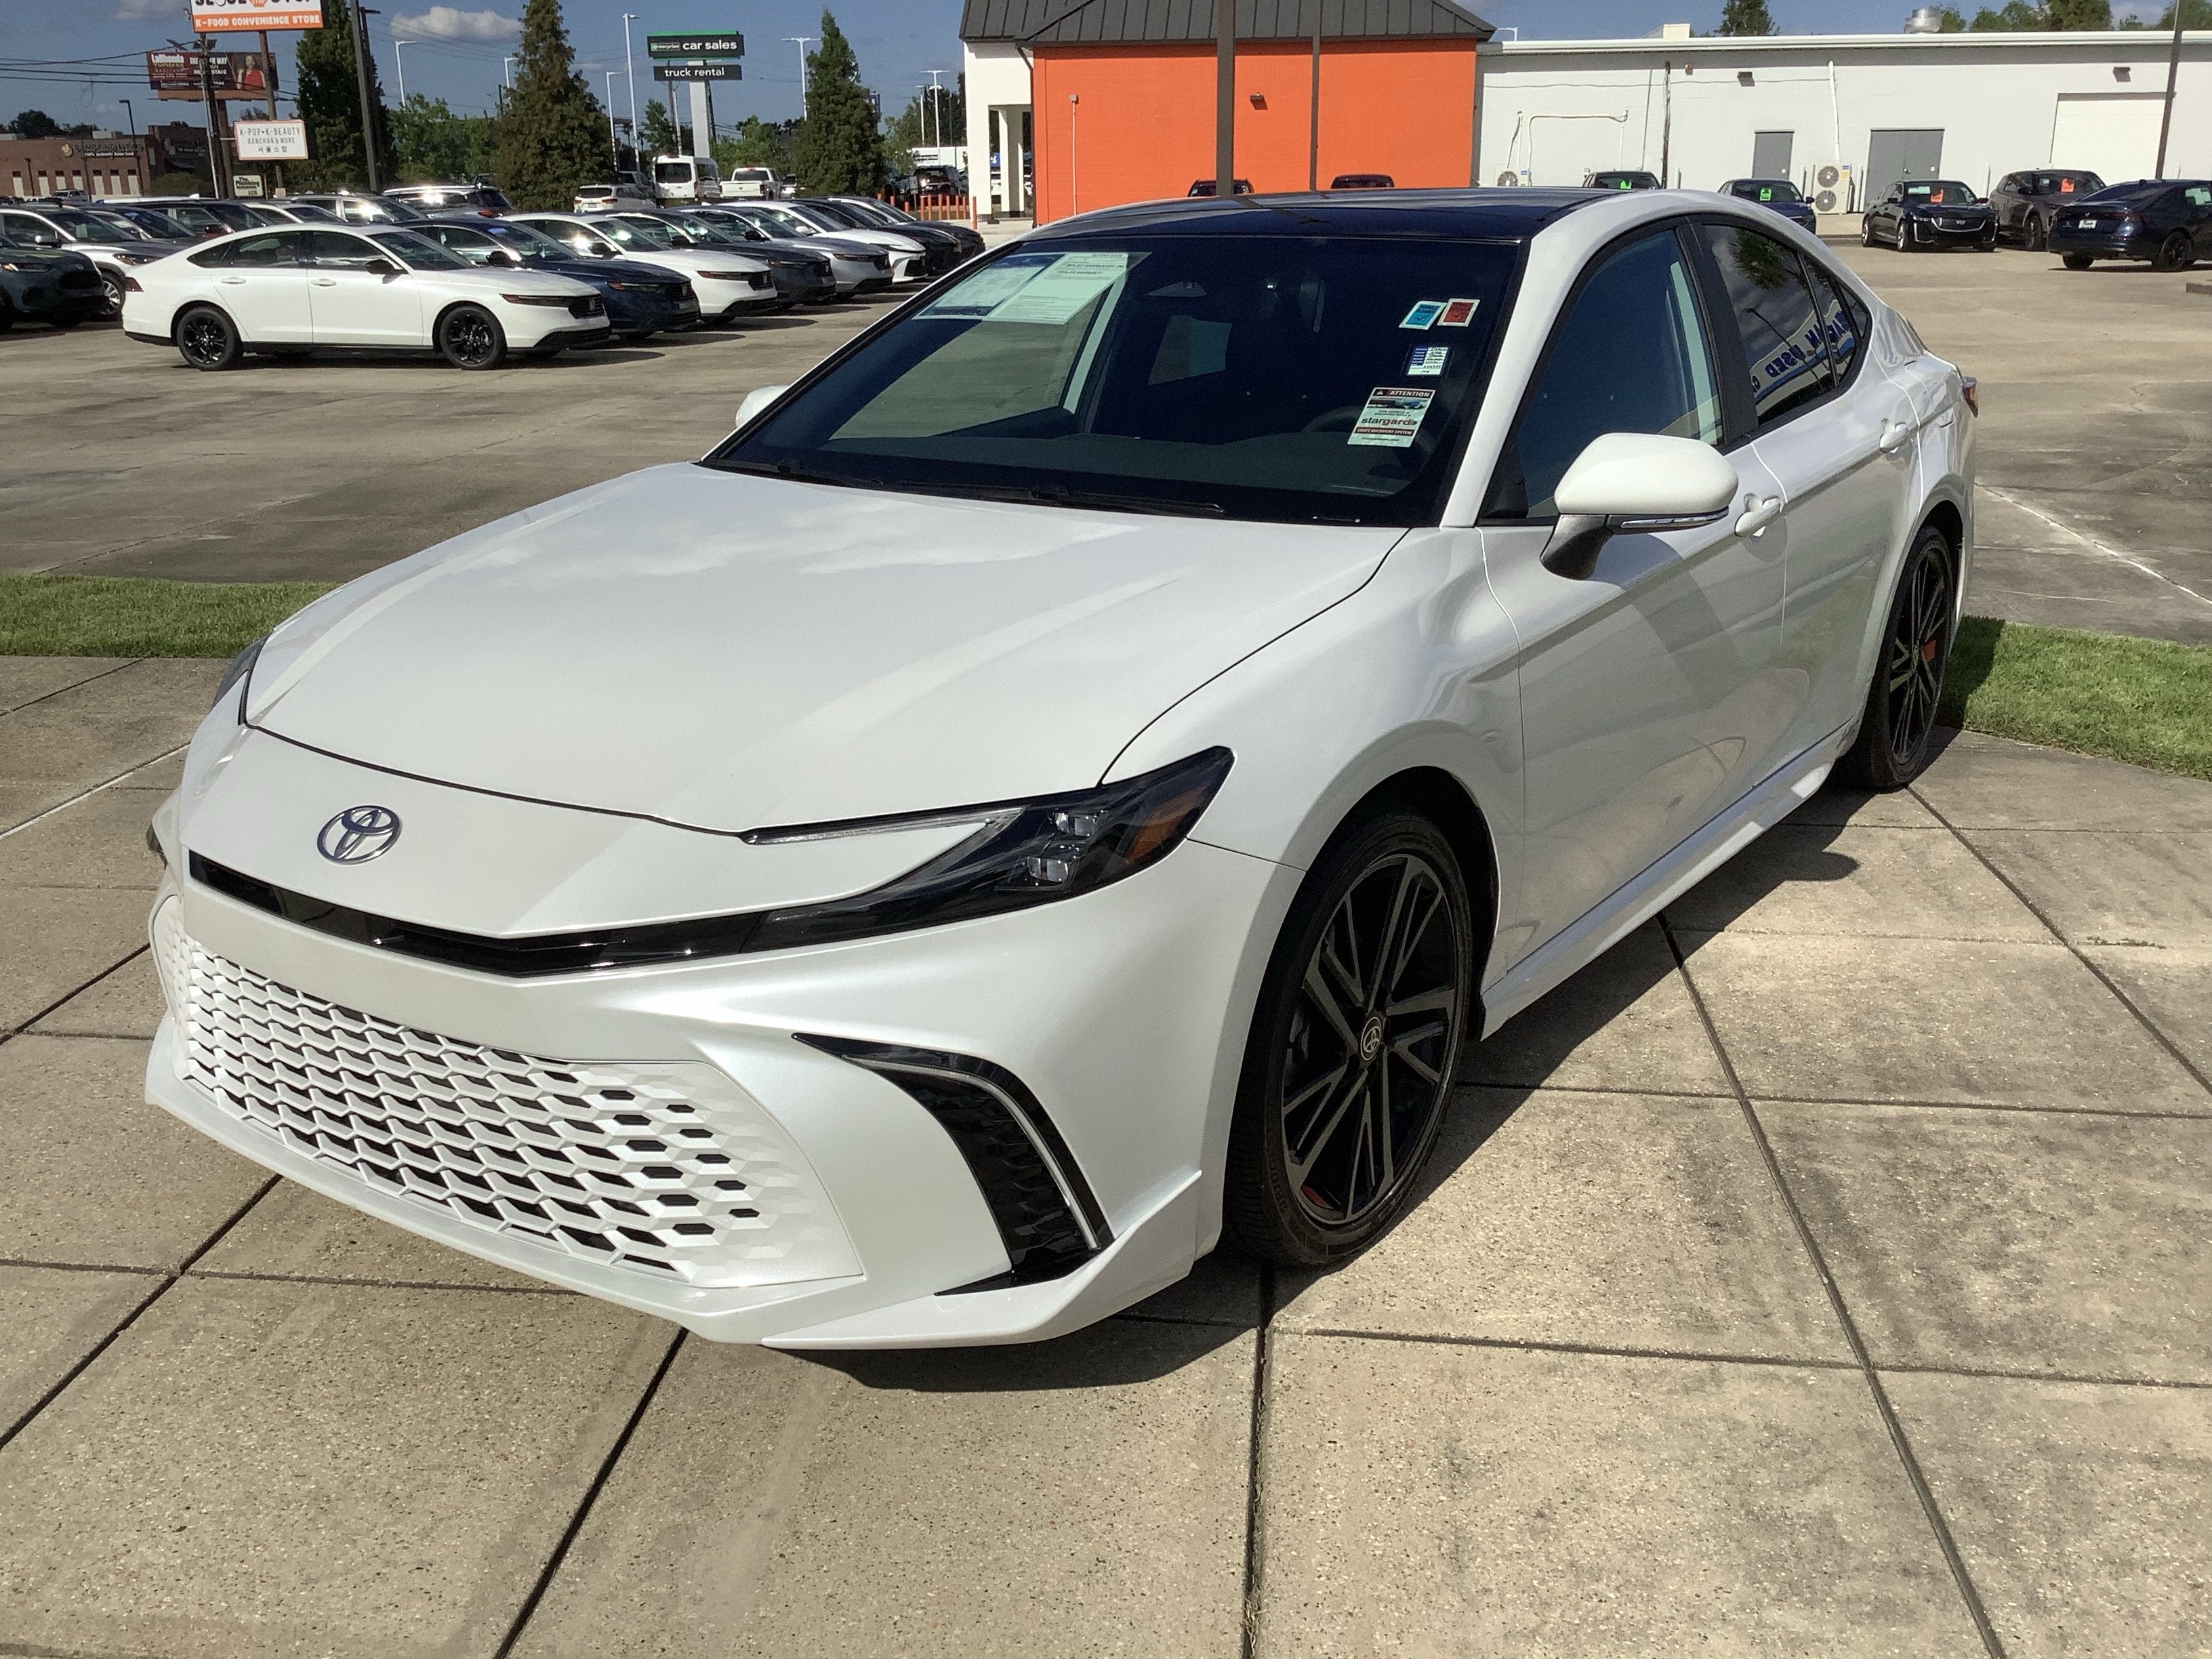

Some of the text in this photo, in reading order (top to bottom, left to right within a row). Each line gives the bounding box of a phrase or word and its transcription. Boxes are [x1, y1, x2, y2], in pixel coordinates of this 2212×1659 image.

[195, 14, 320, 28] K-FOOD CONVENIENCE STORE
[682, 42, 703, 50] car
[705, 39, 737, 50] sales
[664, 66, 725, 77] truck rental
